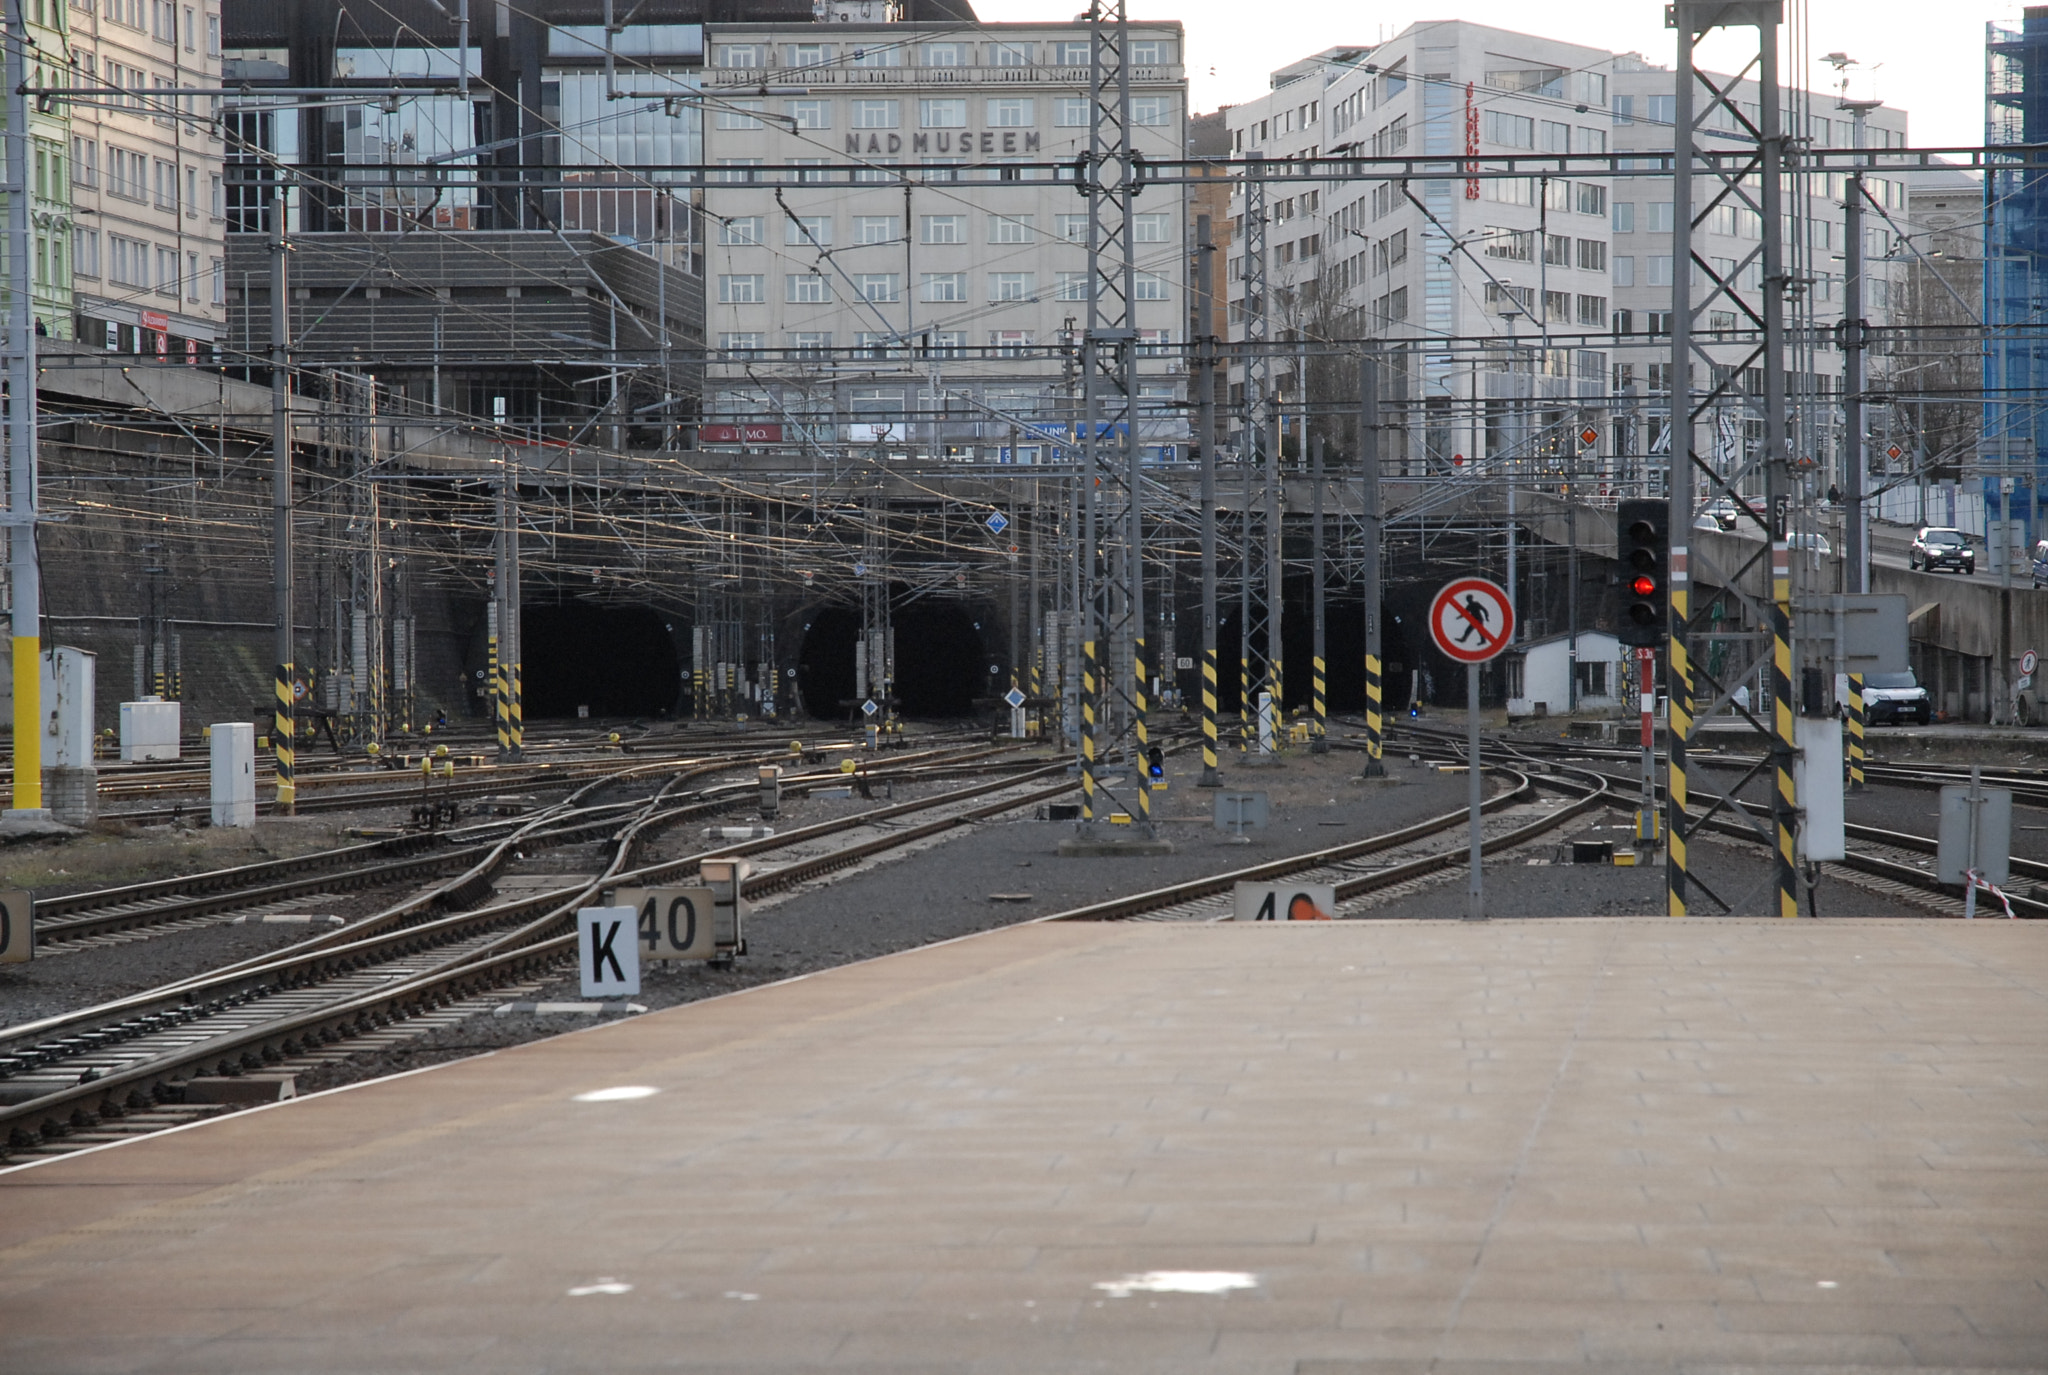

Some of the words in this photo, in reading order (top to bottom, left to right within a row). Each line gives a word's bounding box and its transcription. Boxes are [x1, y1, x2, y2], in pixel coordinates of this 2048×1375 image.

[845, 132, 901, 154] NAD
[913, 131, 1040, 153] MUSEEM
[639, 896, 696, 951] 40
[591, 920, 627, 983] K
